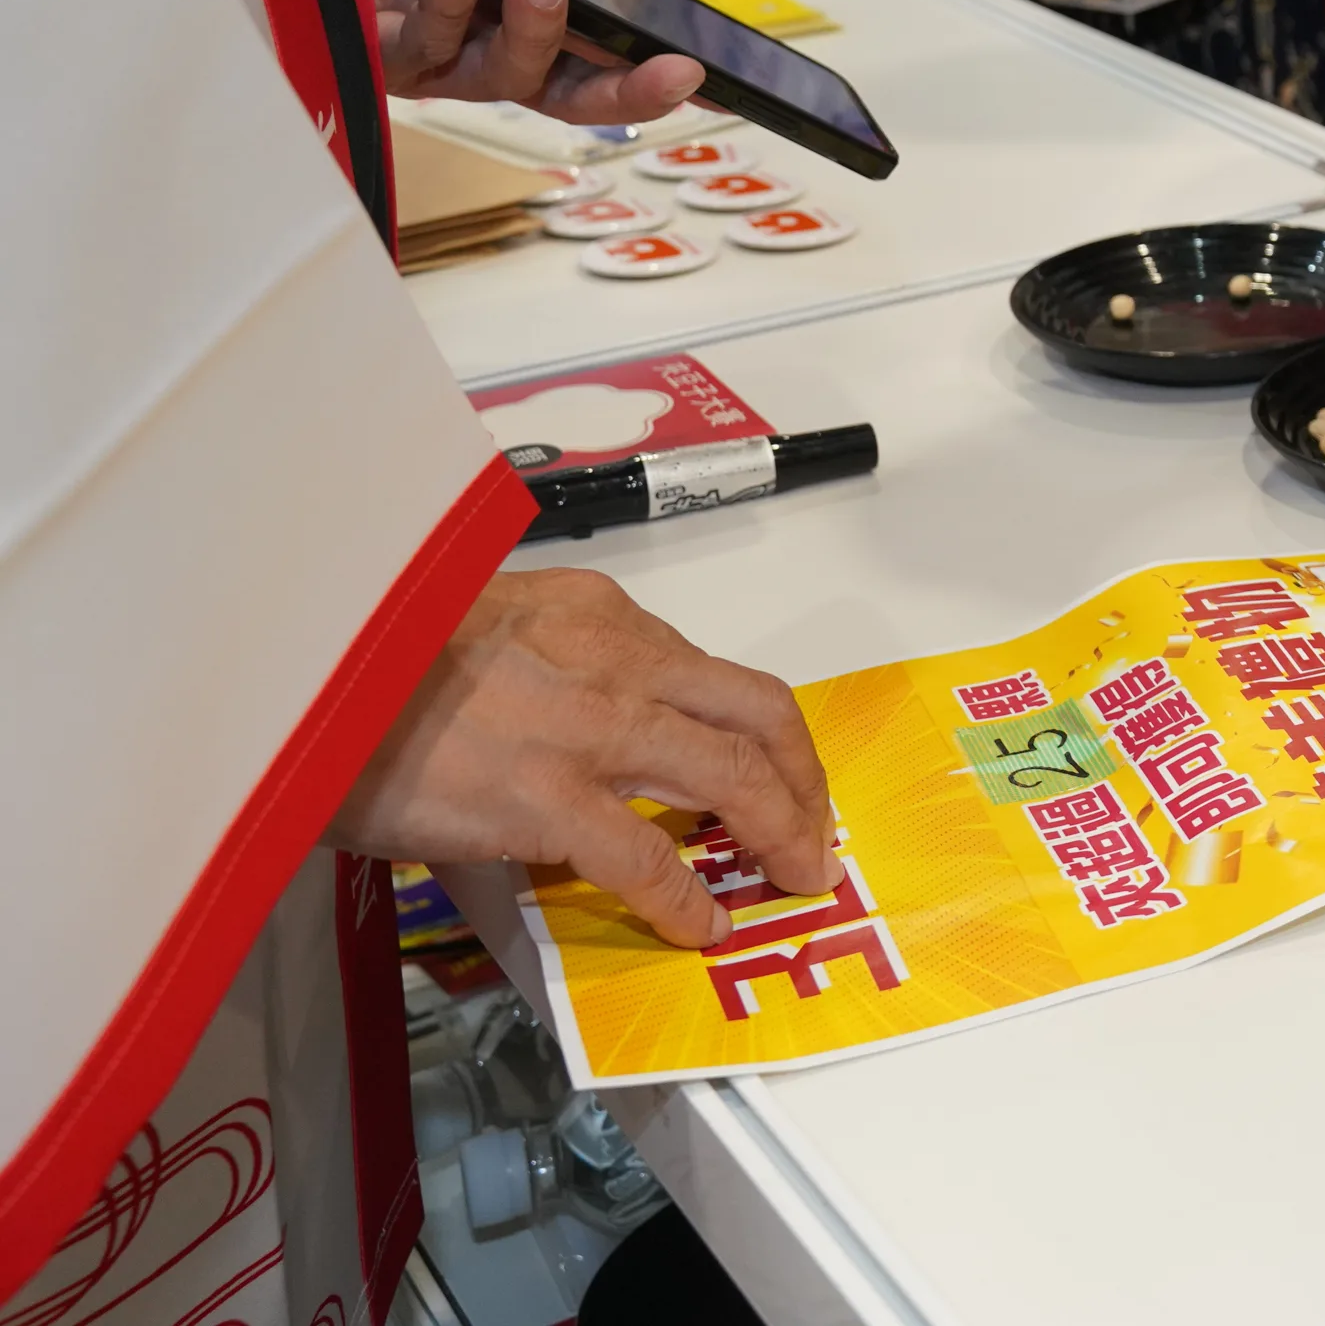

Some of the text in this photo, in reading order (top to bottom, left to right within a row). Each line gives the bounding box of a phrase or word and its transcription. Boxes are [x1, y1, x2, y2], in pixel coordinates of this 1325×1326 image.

[957, 671, 1183, 926] 夾超過 25 顆
[1089, 659, 1263, 841] 即可獲得
